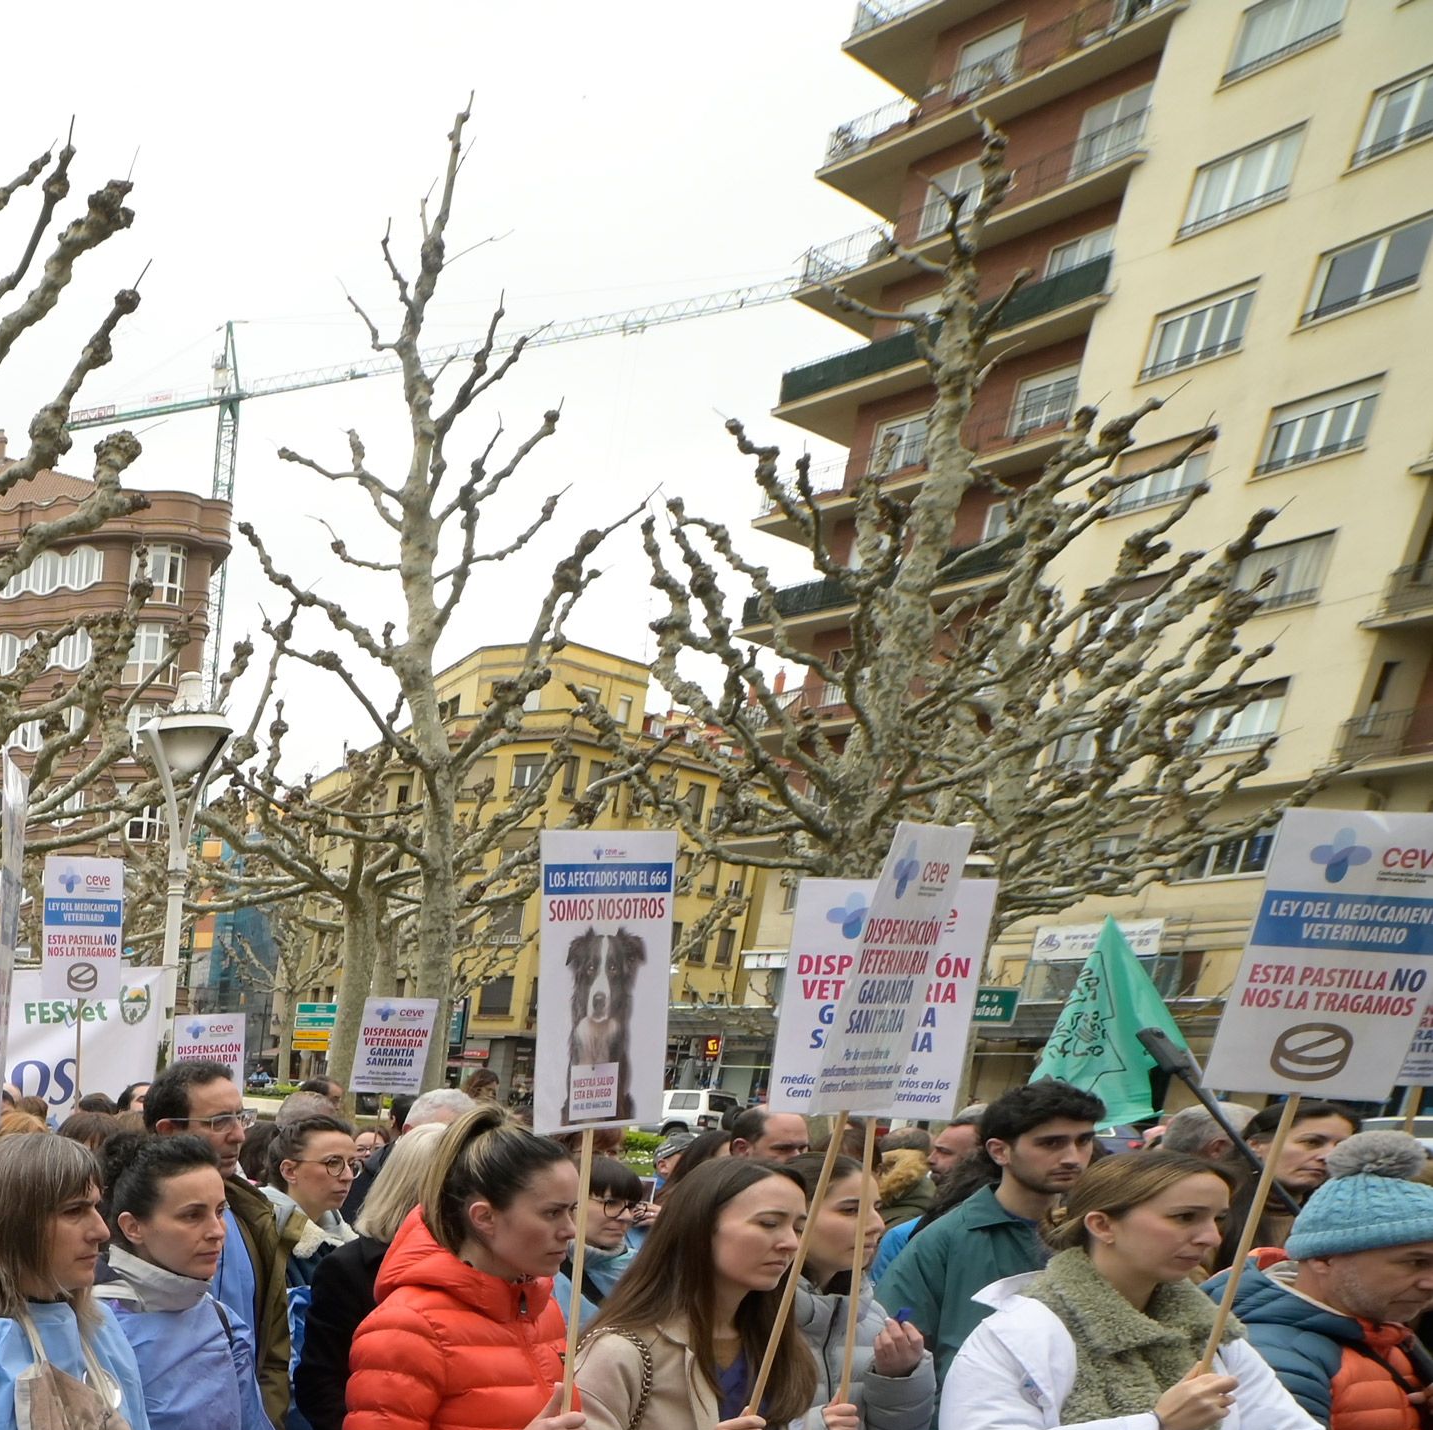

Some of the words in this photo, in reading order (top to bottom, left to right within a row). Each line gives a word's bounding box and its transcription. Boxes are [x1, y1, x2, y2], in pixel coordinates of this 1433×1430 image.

[548, 871, 566, 888] LOS
[567, 870, 619, 887] AFECTADOS
[619, 870, 637, 886] POR
[639, 870, 649, 886] EL
[650, 871, 667, 886] 666
[922, 861, 950, 884] ceve
[85, 874, 111, 887] ceve
[548, 898, 595, 922] SOMOS
[597, 897, 665, 921] NOSOTROS
[1269, 899, 1301, 918] LEY
[1301, 901, 1331, 919] DEL
[863, 915, 943, 945] DISPENSACIÓN
[1301, 923, 1409, 945] VETERINARIO
[47, 934, 67, 945] ESTA
[68, 934, 103, 946] PASTILLA
[104, 933, 117, 946] NO
[47, 946, 64, 957] NOS
[65, 946, 75, 957] LA
[76, 946, 117, 958] TRAGAMOS
[857, 948, 929, 975] VETERINARIA
[1248, 963, 1295, 986] ESTA
[1298, 966, 1389, 991] PASTILLA
[1389, 968, 1427, 993] NO
[858, 975, 914, 1004] GARANTÍA
[979, 994, 990, 1003] de
[992, 994, 999, 1003] la
[1240, 987, 1283, 1008] NOS
[1283, 989, 1309, 1010] LA
[1312, 991, 1417, 1017] TRAGAMOS
[399, 1008, 425, 1018] ceve
[845, 1008, 905, 1034] SANITARIA
[209, 1024, 234, 1033] ceve
[363, 1026, 428, 1038] DISPENSACIÓN
[177, 1042, 241, 1055] DISPENSACIÓN
[364, 1037, 423, 1048] VETERINARIA
[369, 1046, 415, 1058] GARANTÍA
[365, 1057, 413, 1068] SANITARIA
[906, 1065, 919, 1075] de
[921, 1081, 933, 1089] en
[934, 1079, 950, 1091] los
